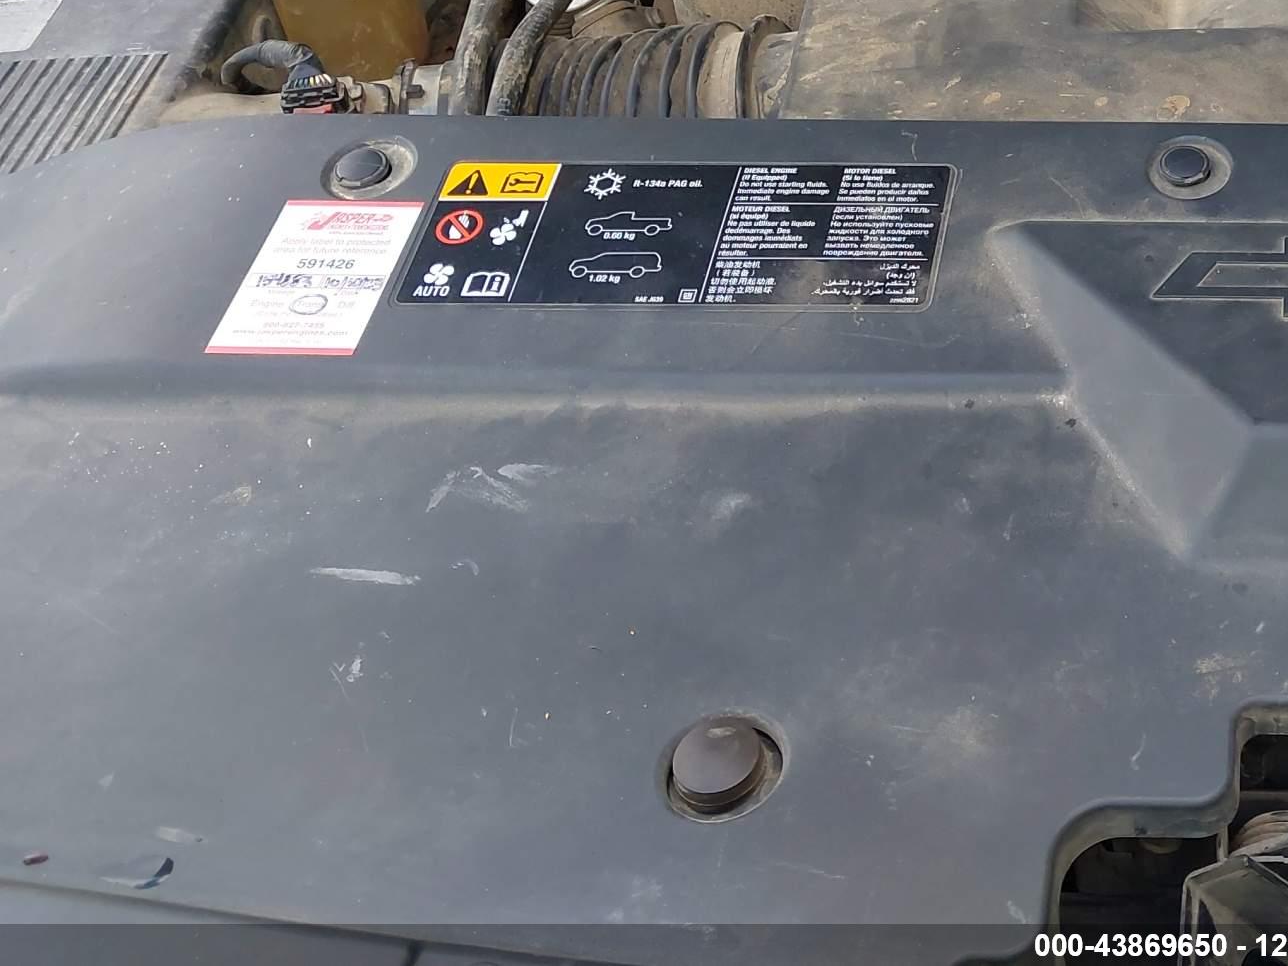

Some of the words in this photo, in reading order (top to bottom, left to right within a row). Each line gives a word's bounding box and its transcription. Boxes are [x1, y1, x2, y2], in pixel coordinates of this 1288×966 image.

[633, 179, 666, 187] R-134a
[668, 179, 688, 187] PAG
[689, 179, 703, 187] oil.
[624, 232, 635, 240] kg
[296, 258, 356, 269] 591426
[608, 275, 621, 283] kg
[412, 286, 450, 296] AUTO
